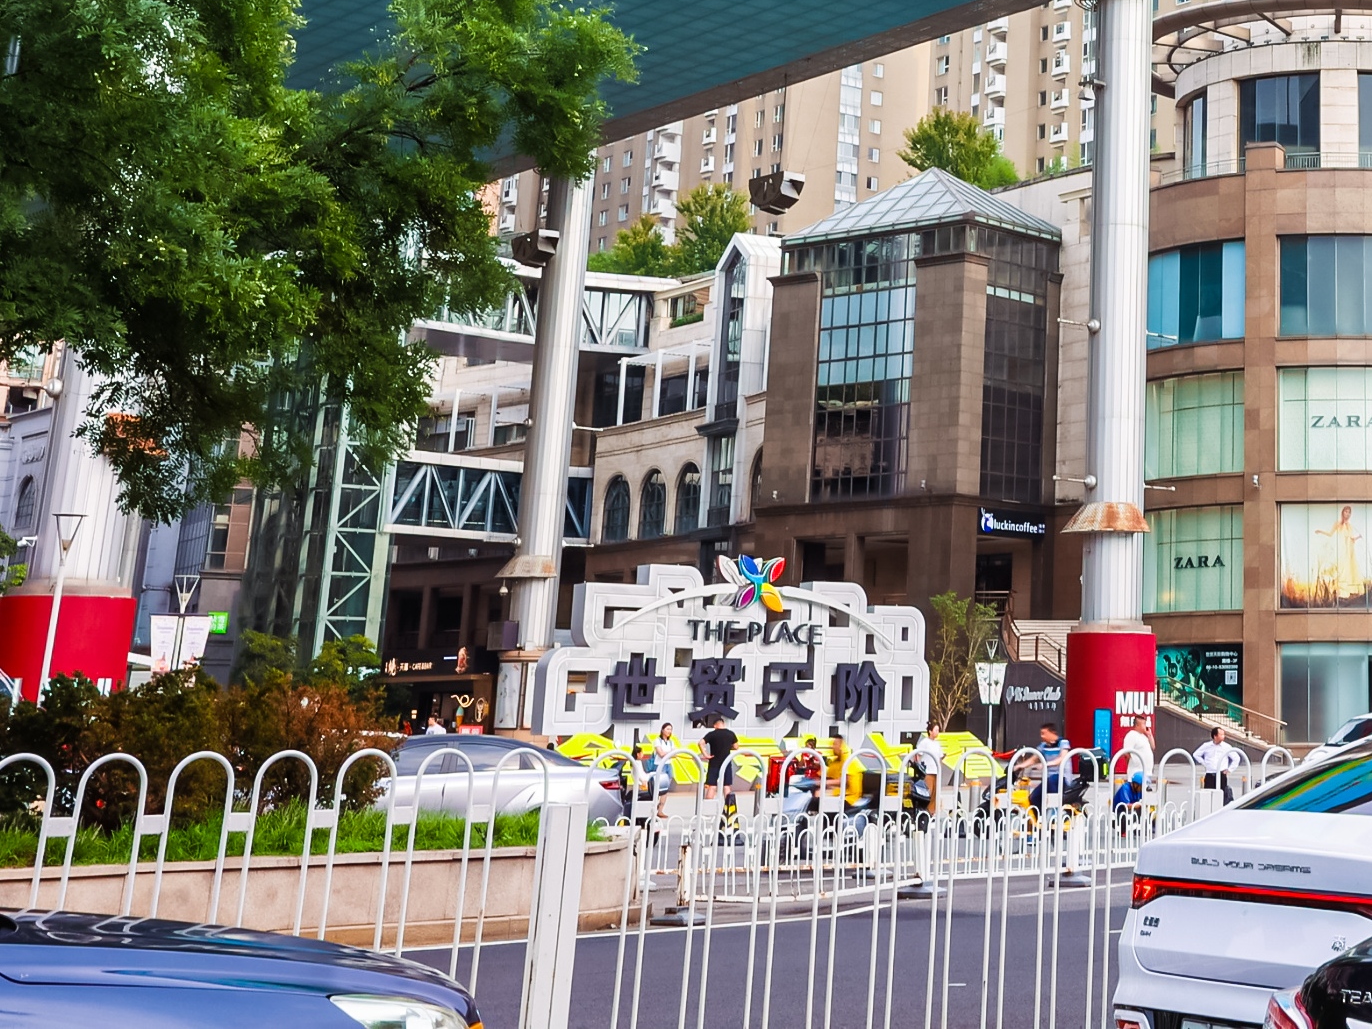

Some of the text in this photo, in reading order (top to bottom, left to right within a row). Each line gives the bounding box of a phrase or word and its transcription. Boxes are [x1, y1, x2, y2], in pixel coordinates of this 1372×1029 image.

[1173, 554, 1226, 570] ZARA
[687, 619, 823, 646] THE PLACE
[605, 656, 888, 723] 世贸天阶
[1115, 691, 1154, 715] MUJI
